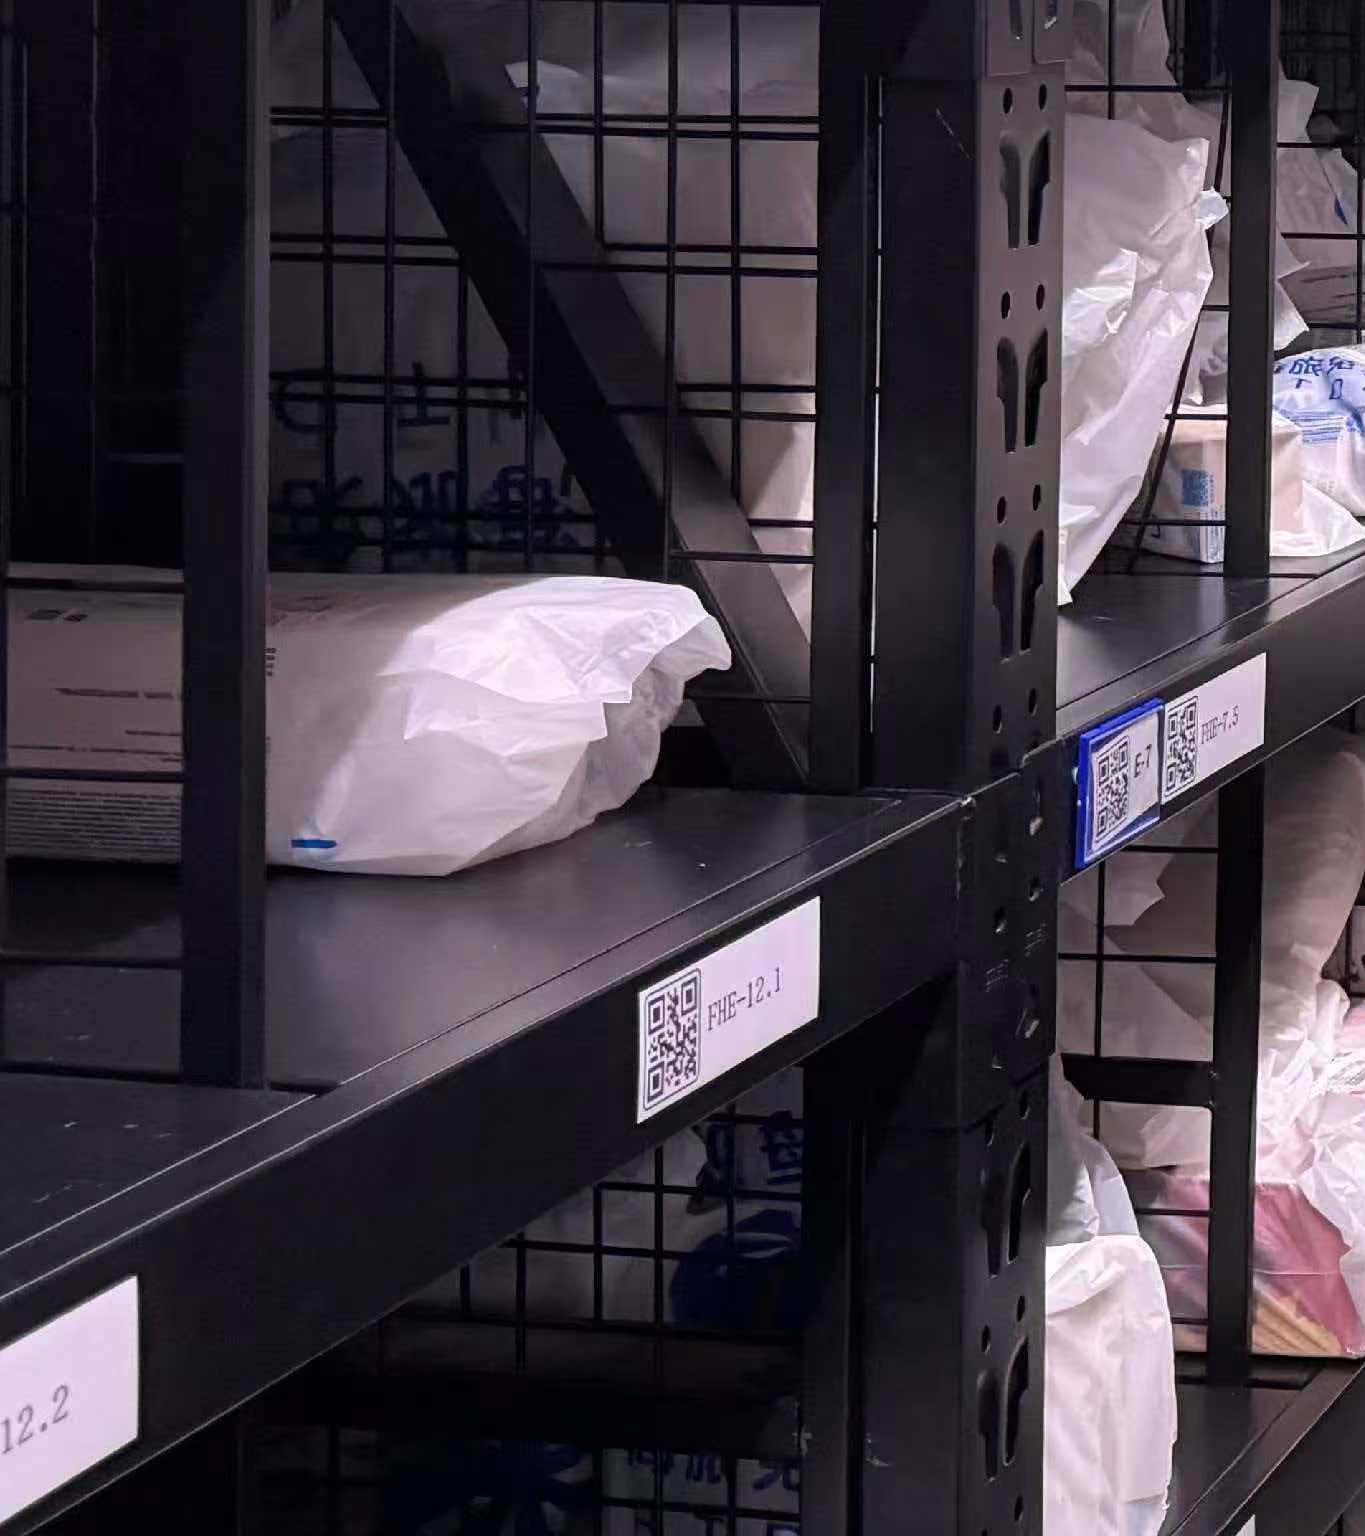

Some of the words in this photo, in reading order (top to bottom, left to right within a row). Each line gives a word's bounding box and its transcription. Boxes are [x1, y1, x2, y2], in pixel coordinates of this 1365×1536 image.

[1201, 705, 1239, 745] FHE-7.5
[1134, 743, 1153, 778] E-7
[708, 967, 780, 1031] FHE-12.1
